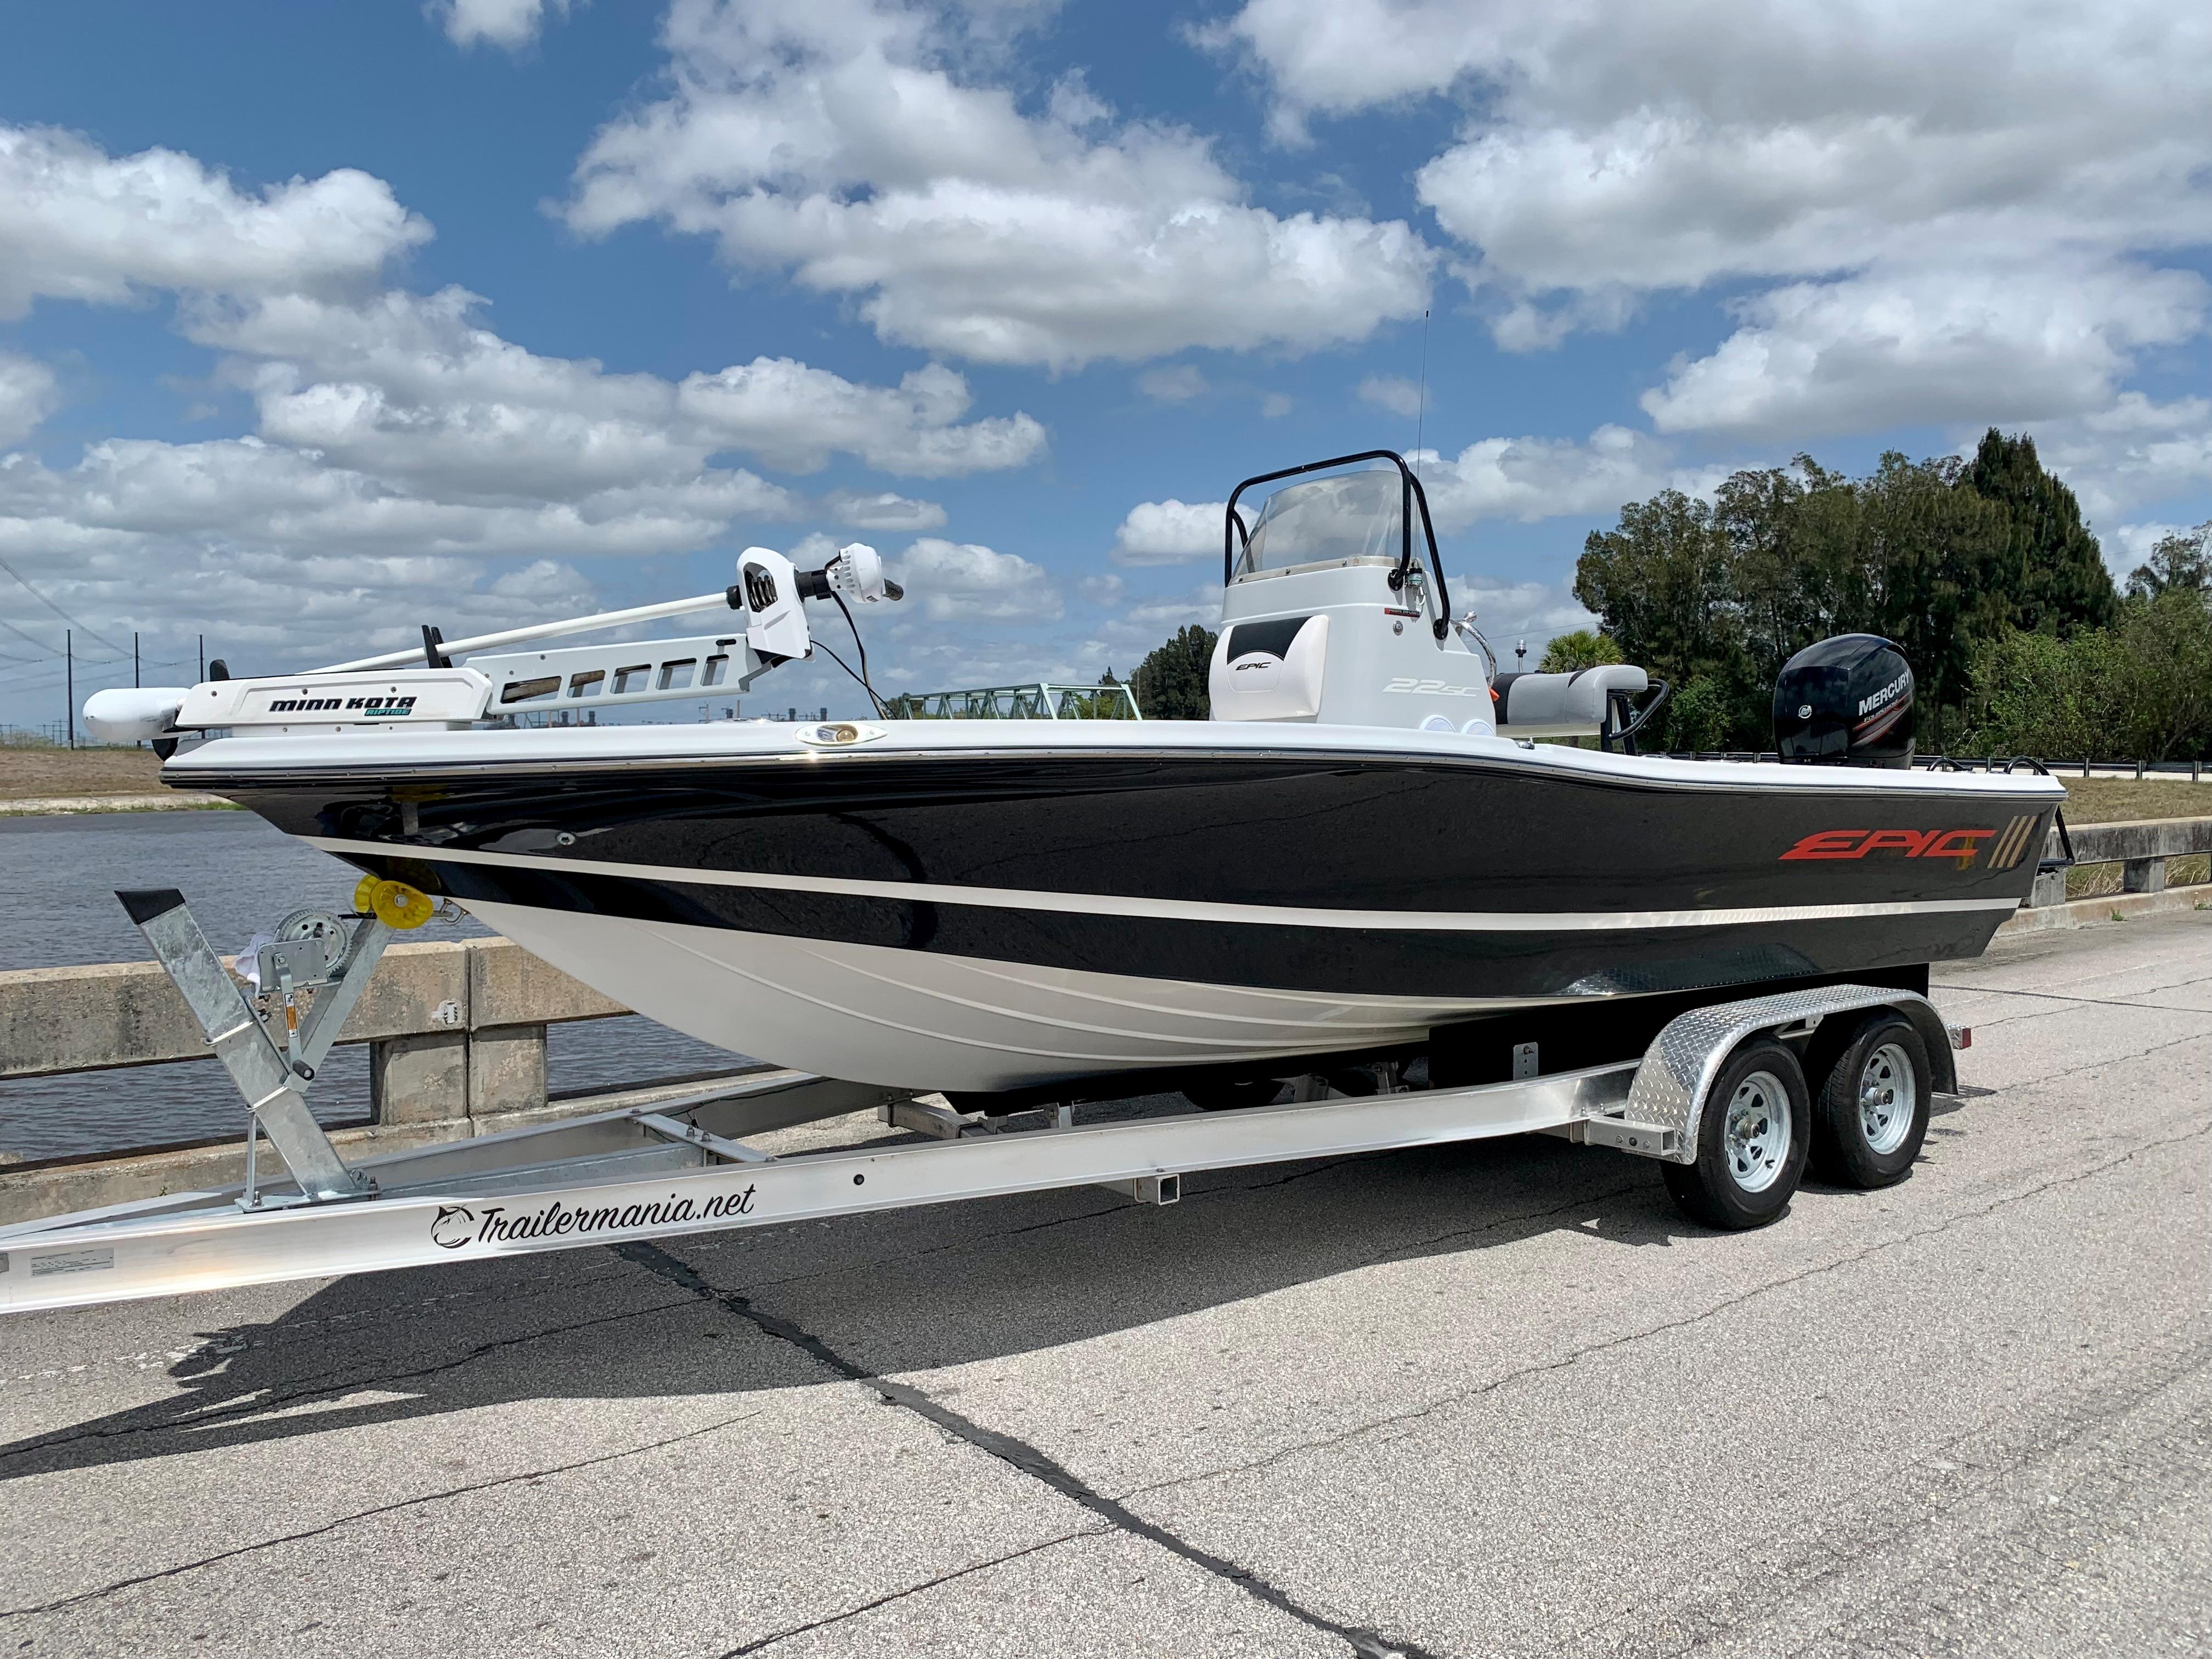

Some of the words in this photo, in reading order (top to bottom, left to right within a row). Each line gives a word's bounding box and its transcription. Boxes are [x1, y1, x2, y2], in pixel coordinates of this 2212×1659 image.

[1235, 662, 1272, 670] EPIC
[268, 698, 343, 712] MINN
[344, 696, 417, 709] KOTA
[1858, 668, 1909, 716] MERCURY
[1778, 830, 1997, 860] EPIC
[478, 1183, 757, 1243] Trailermania.net
